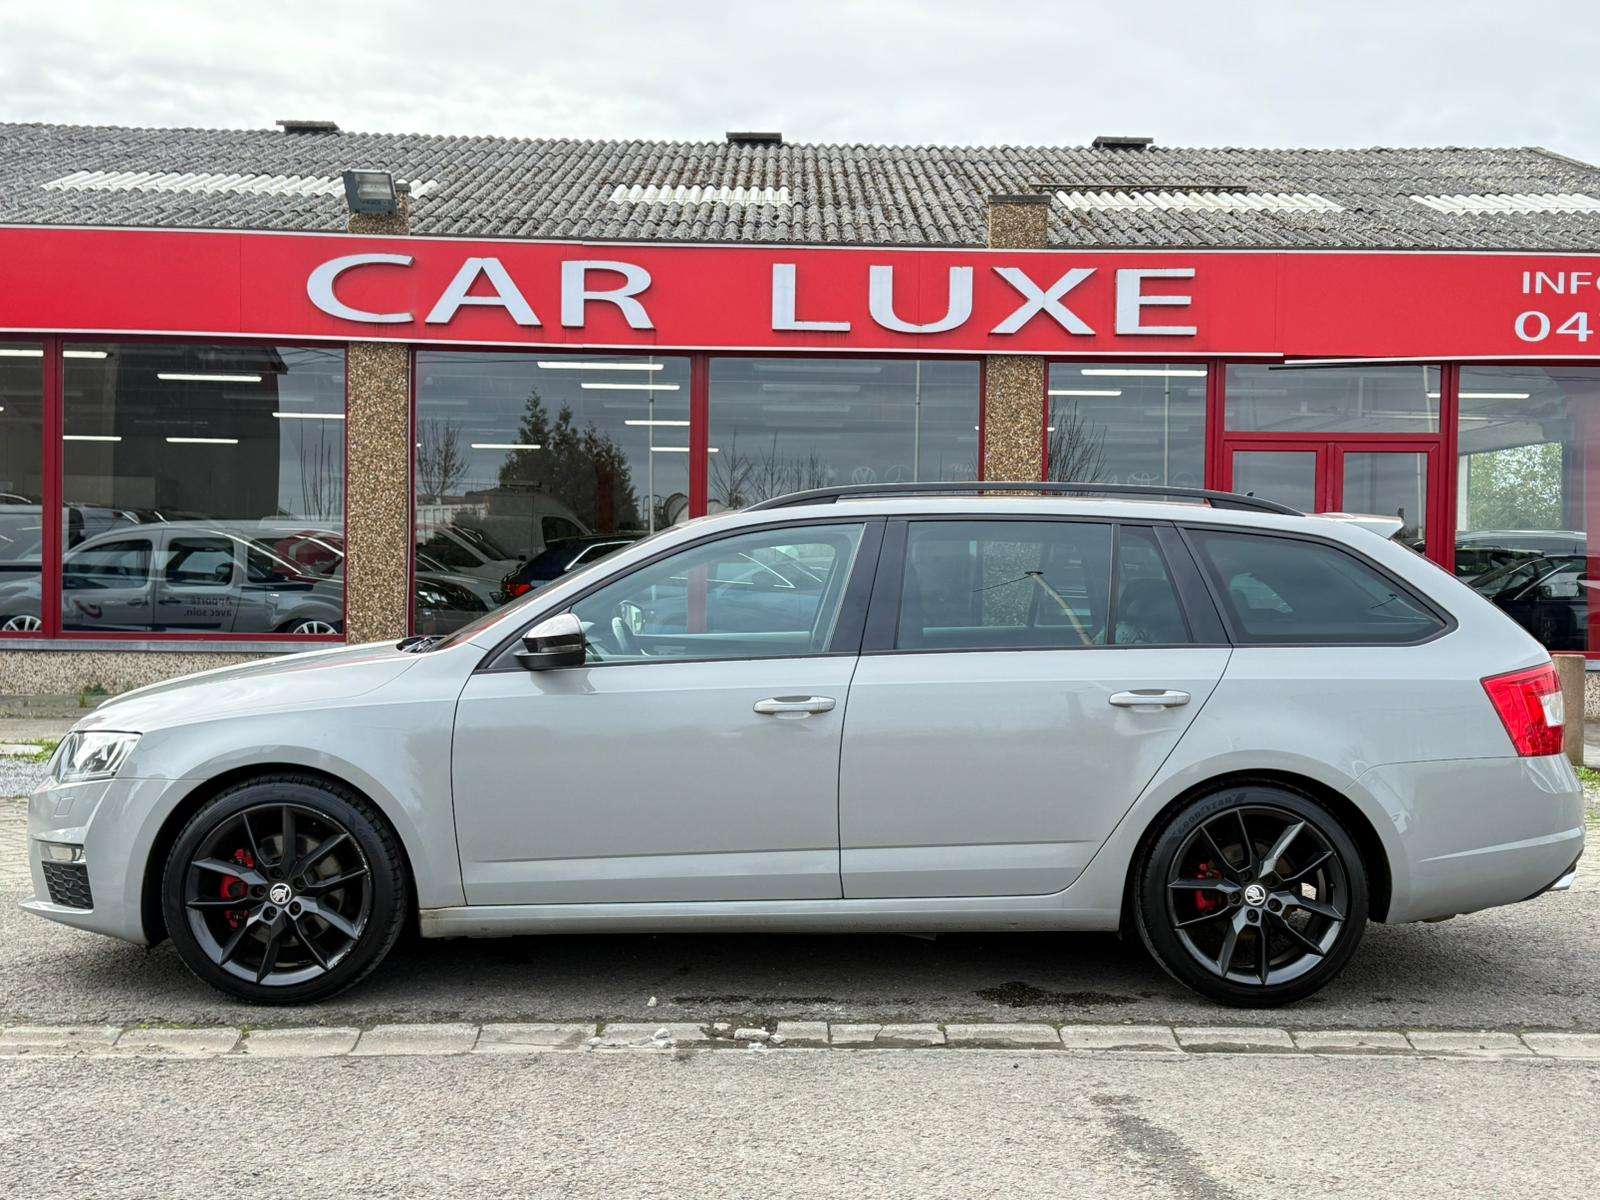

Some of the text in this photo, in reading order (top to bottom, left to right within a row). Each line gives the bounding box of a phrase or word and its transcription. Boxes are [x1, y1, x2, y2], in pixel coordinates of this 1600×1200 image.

[307, 253, 1198, 336] CAR LUXE
[1523, 271, 1600, 294] INF
[1514, 311, 1600, 342] 04
